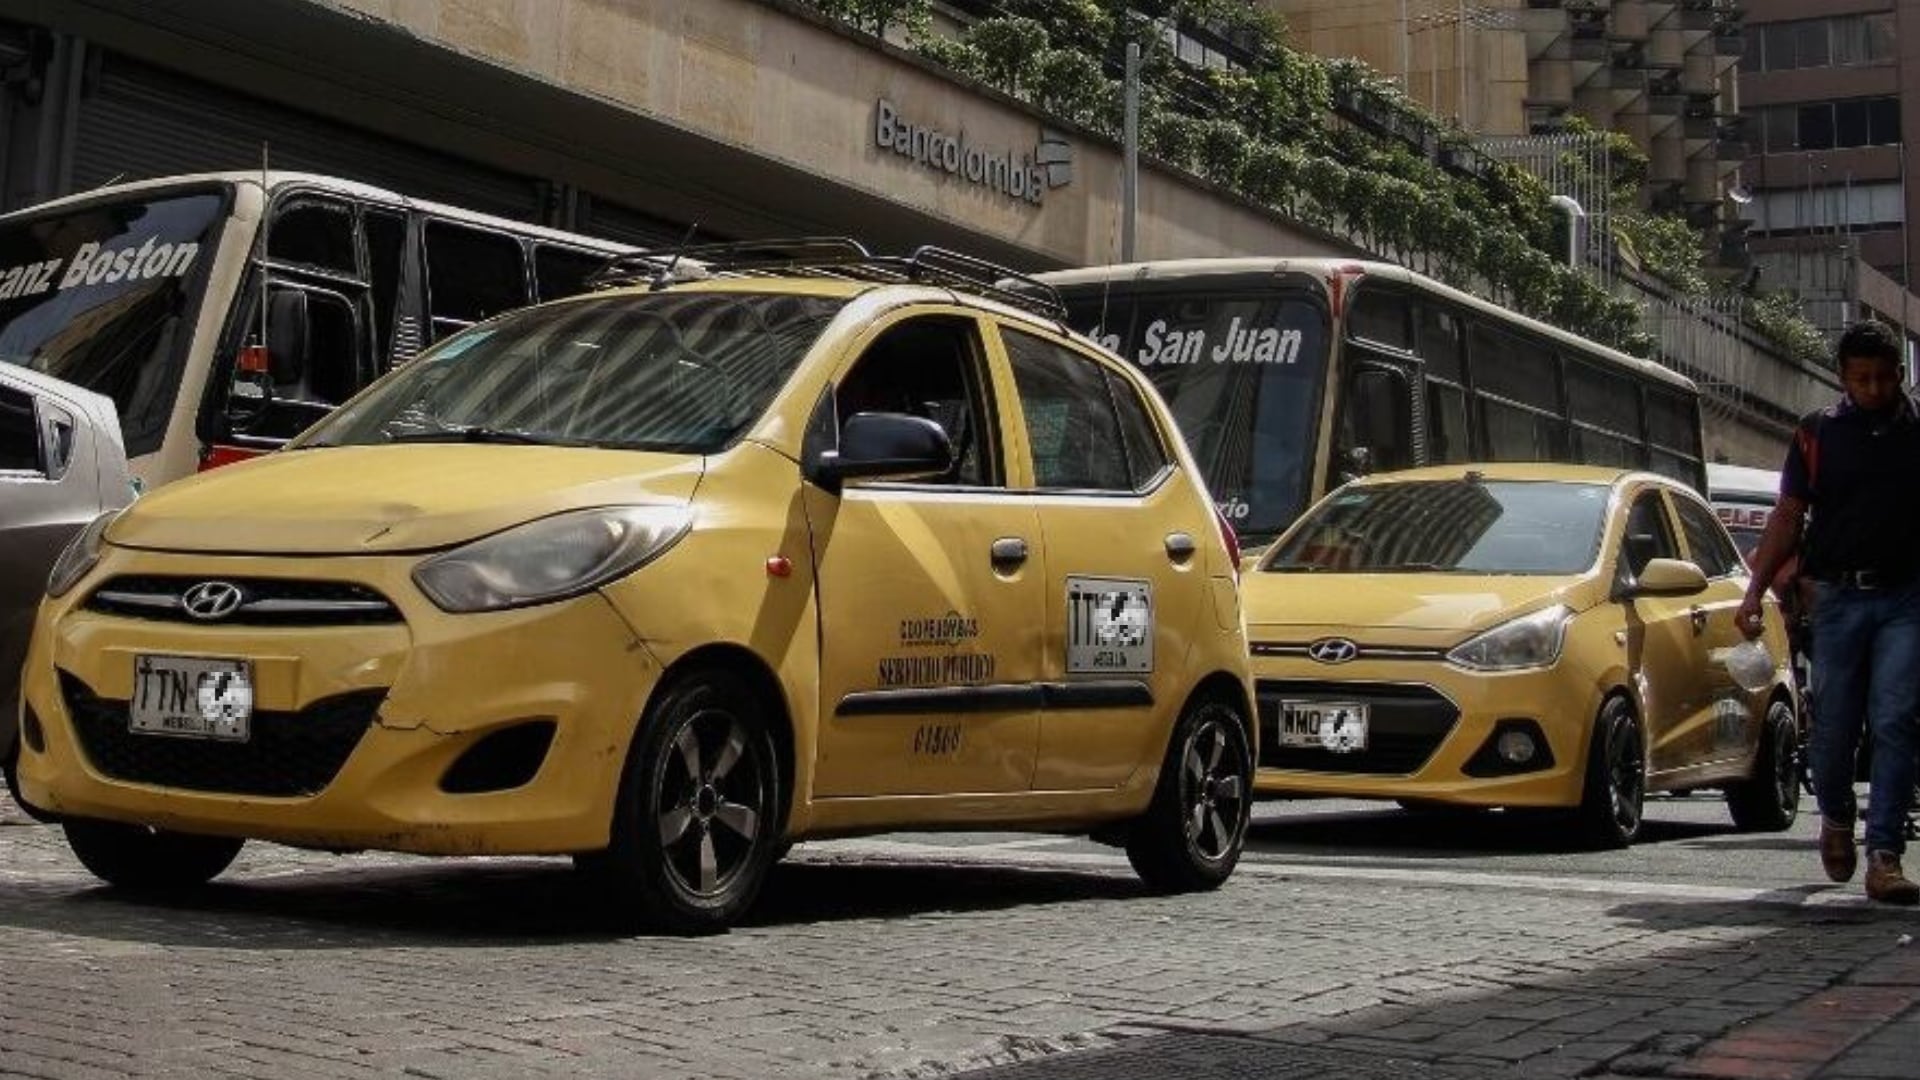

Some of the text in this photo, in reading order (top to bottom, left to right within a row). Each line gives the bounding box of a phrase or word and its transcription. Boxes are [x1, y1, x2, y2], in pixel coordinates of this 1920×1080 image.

[876, 98, 1048, 207] Bancolombia
[0, 234, 199, 300] anz Boston
[1139, 319, 1206, 366] San
[1212, 316, 1302, 364] Juan
